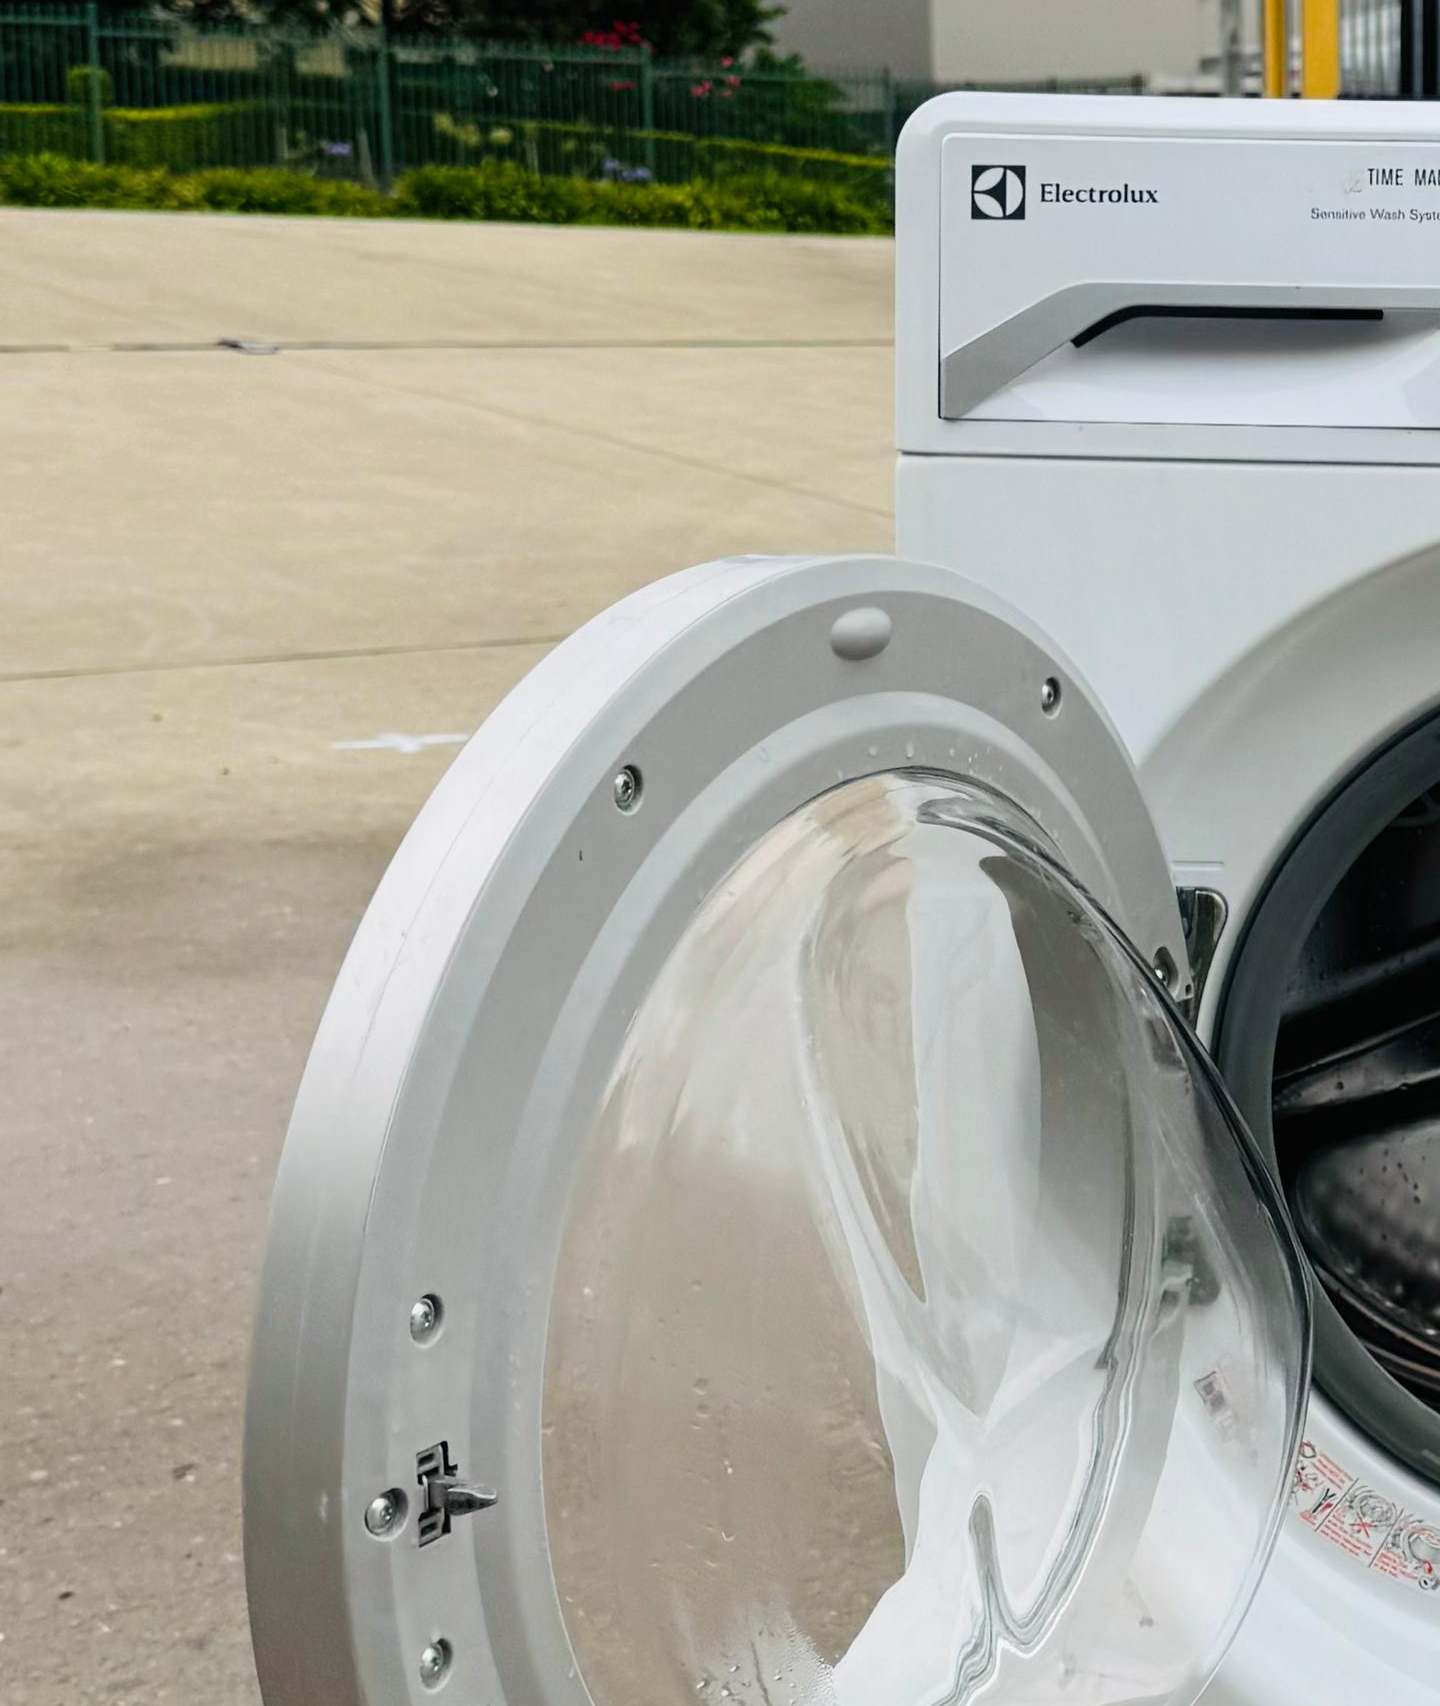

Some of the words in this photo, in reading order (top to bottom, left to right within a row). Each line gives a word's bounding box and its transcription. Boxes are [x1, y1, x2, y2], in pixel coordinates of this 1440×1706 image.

[1368, 168, 1403, 186] TIME
[1040, 183, 1159, 203] Electrolux
[1311, 207, 1366, 220] Sensitive
[1370, 208, 1405, 220] Wash
